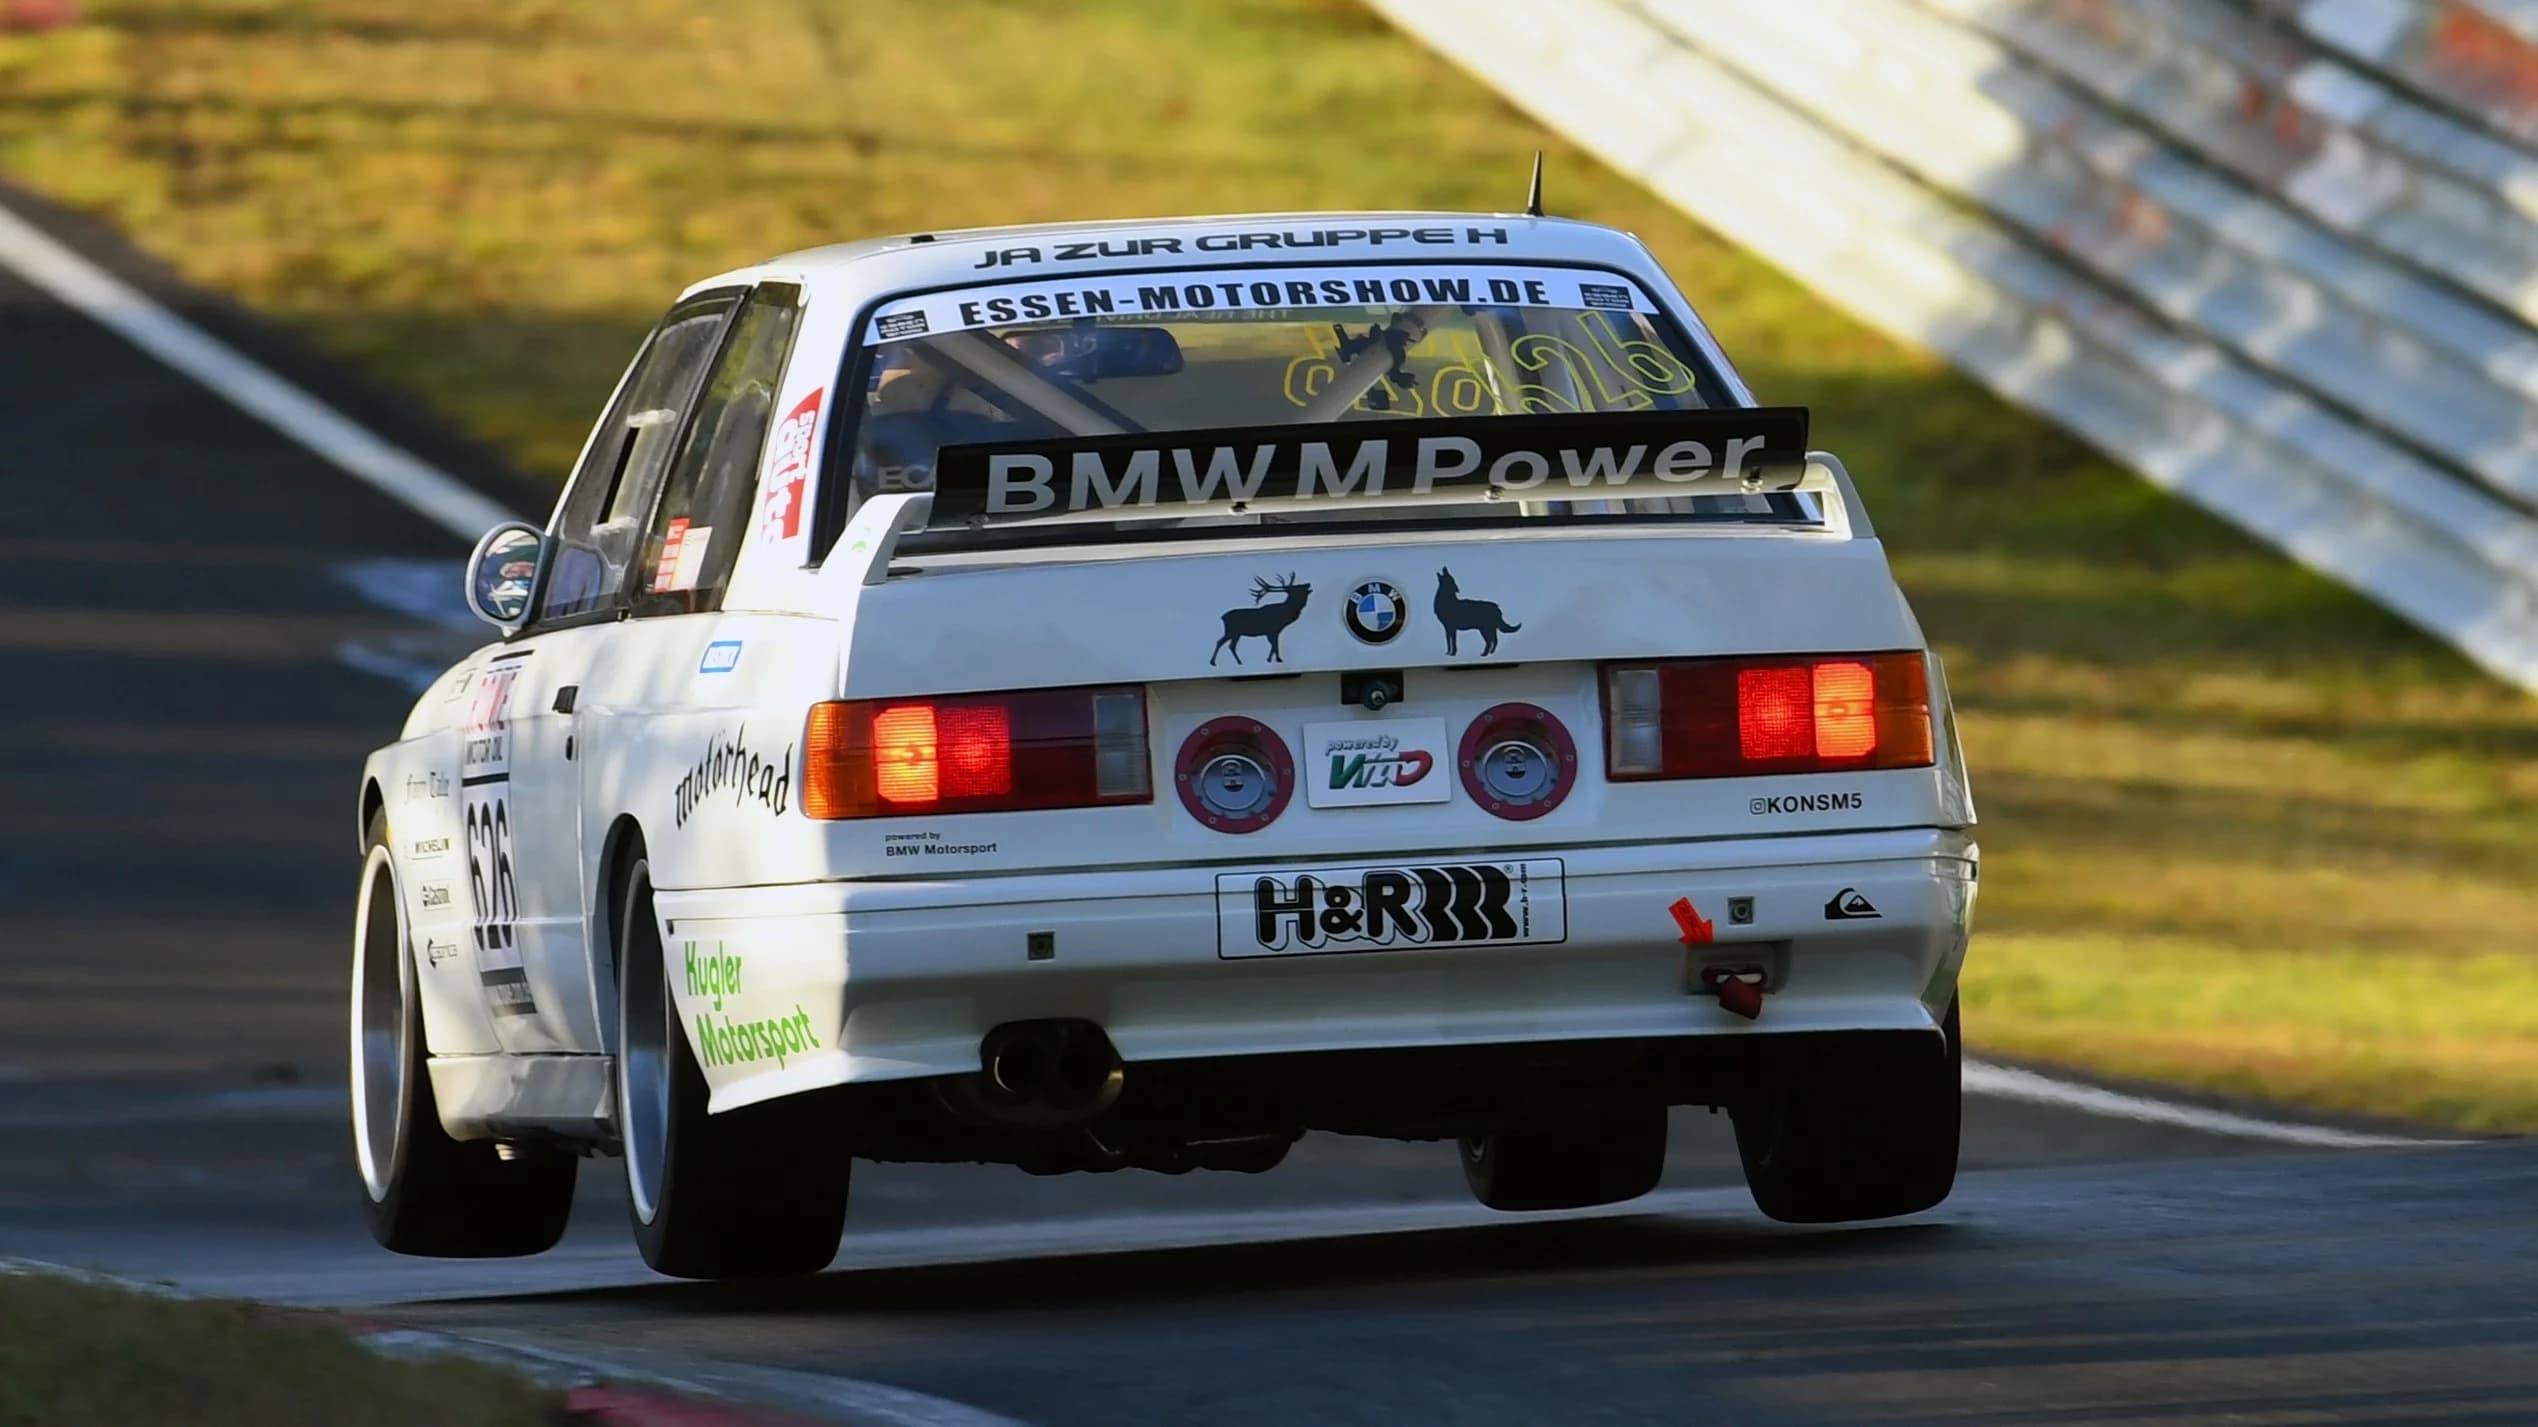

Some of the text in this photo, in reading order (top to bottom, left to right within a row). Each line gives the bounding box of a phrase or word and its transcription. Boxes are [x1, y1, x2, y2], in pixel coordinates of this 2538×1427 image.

[973, 227, 1509, 269] JA ZUR GRUPPE H
[958, 278, 1551, 327] ESSEN-MOTORSHOW.DE
[985, 434, 1766, 514] BMW M Power
[1350, 583, 1402, 604] BMW
[885, 832, 941, 842] powered by
[886, 843, 998, 857] BMW Motorsport
[466, 798, 518, 952] 626
[685, 940, 742, 1011] Kugler
[696, 1003, 821, 1071] Motorsport
